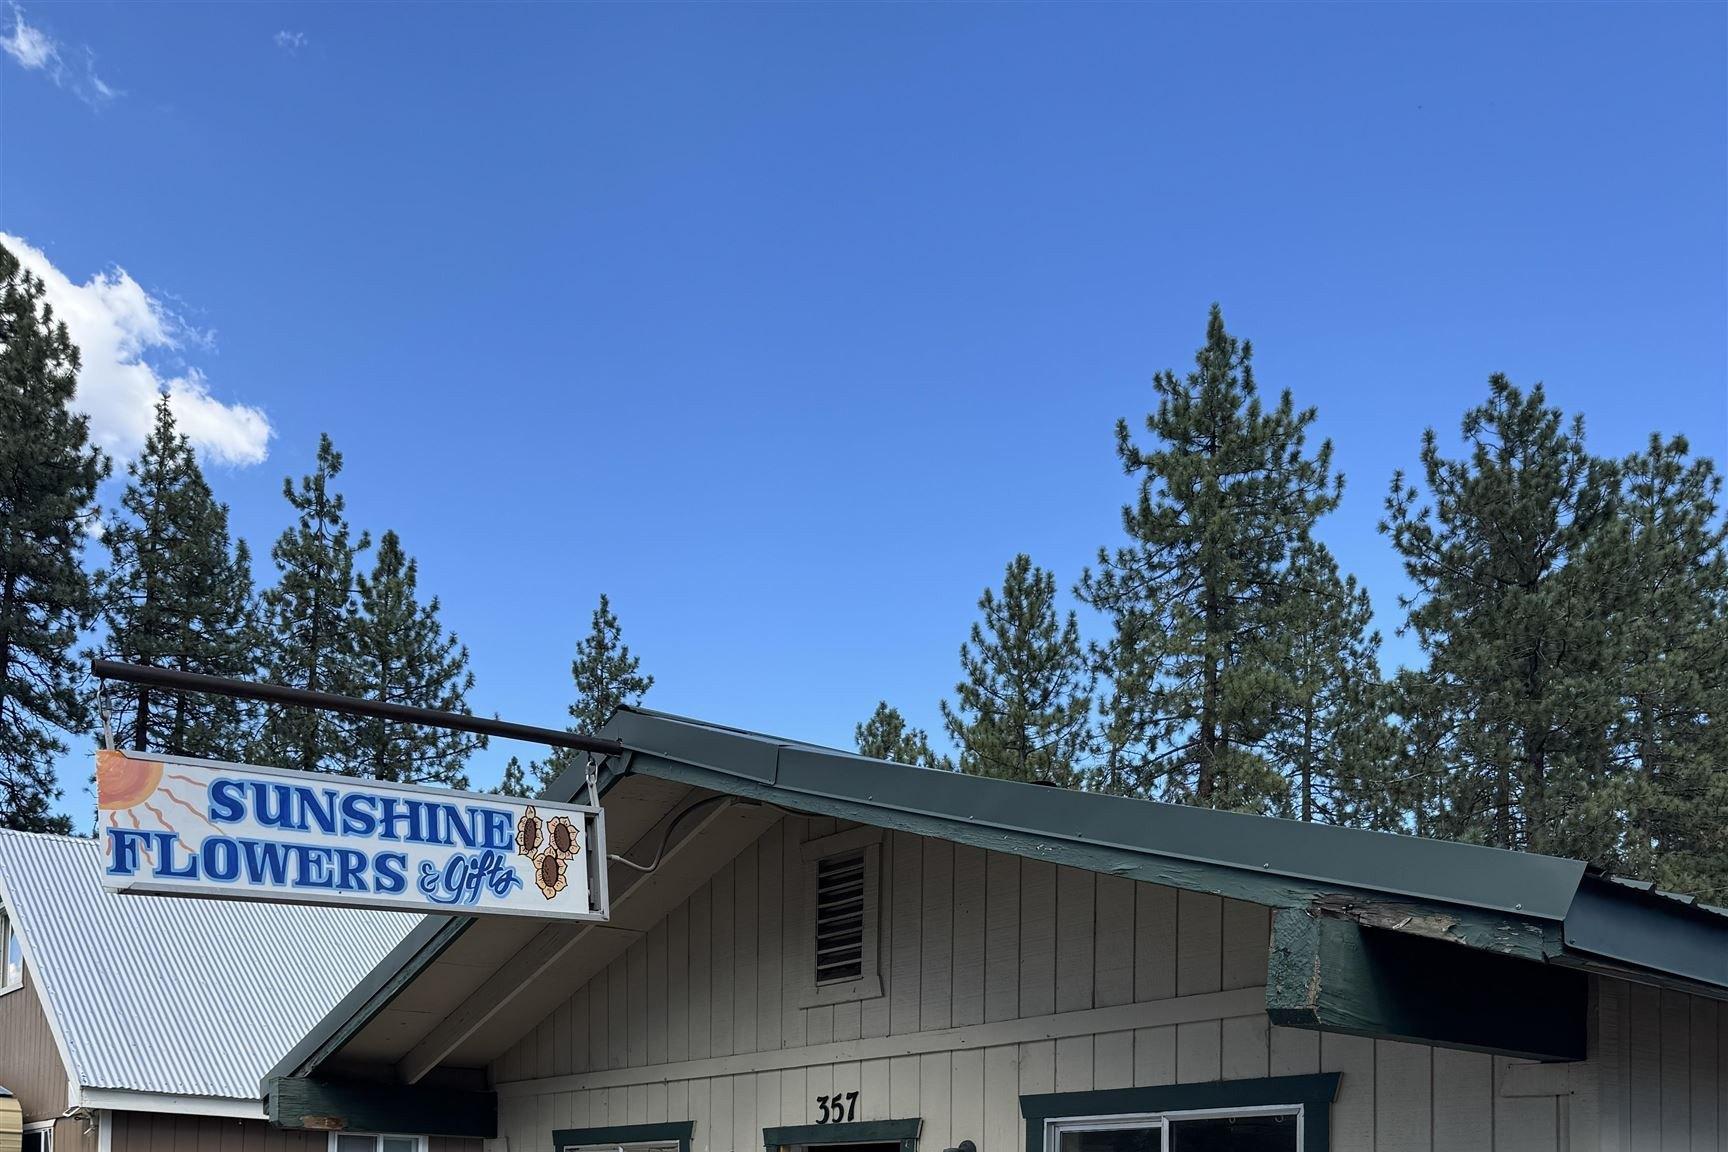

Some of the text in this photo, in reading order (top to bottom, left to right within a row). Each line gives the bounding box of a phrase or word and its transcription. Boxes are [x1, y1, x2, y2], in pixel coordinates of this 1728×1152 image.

[208, 778, 513, 851] SUNSHINE
[106, 827, 408, 894] FLOWERS
[815, 1091, 859, 1124] 357
